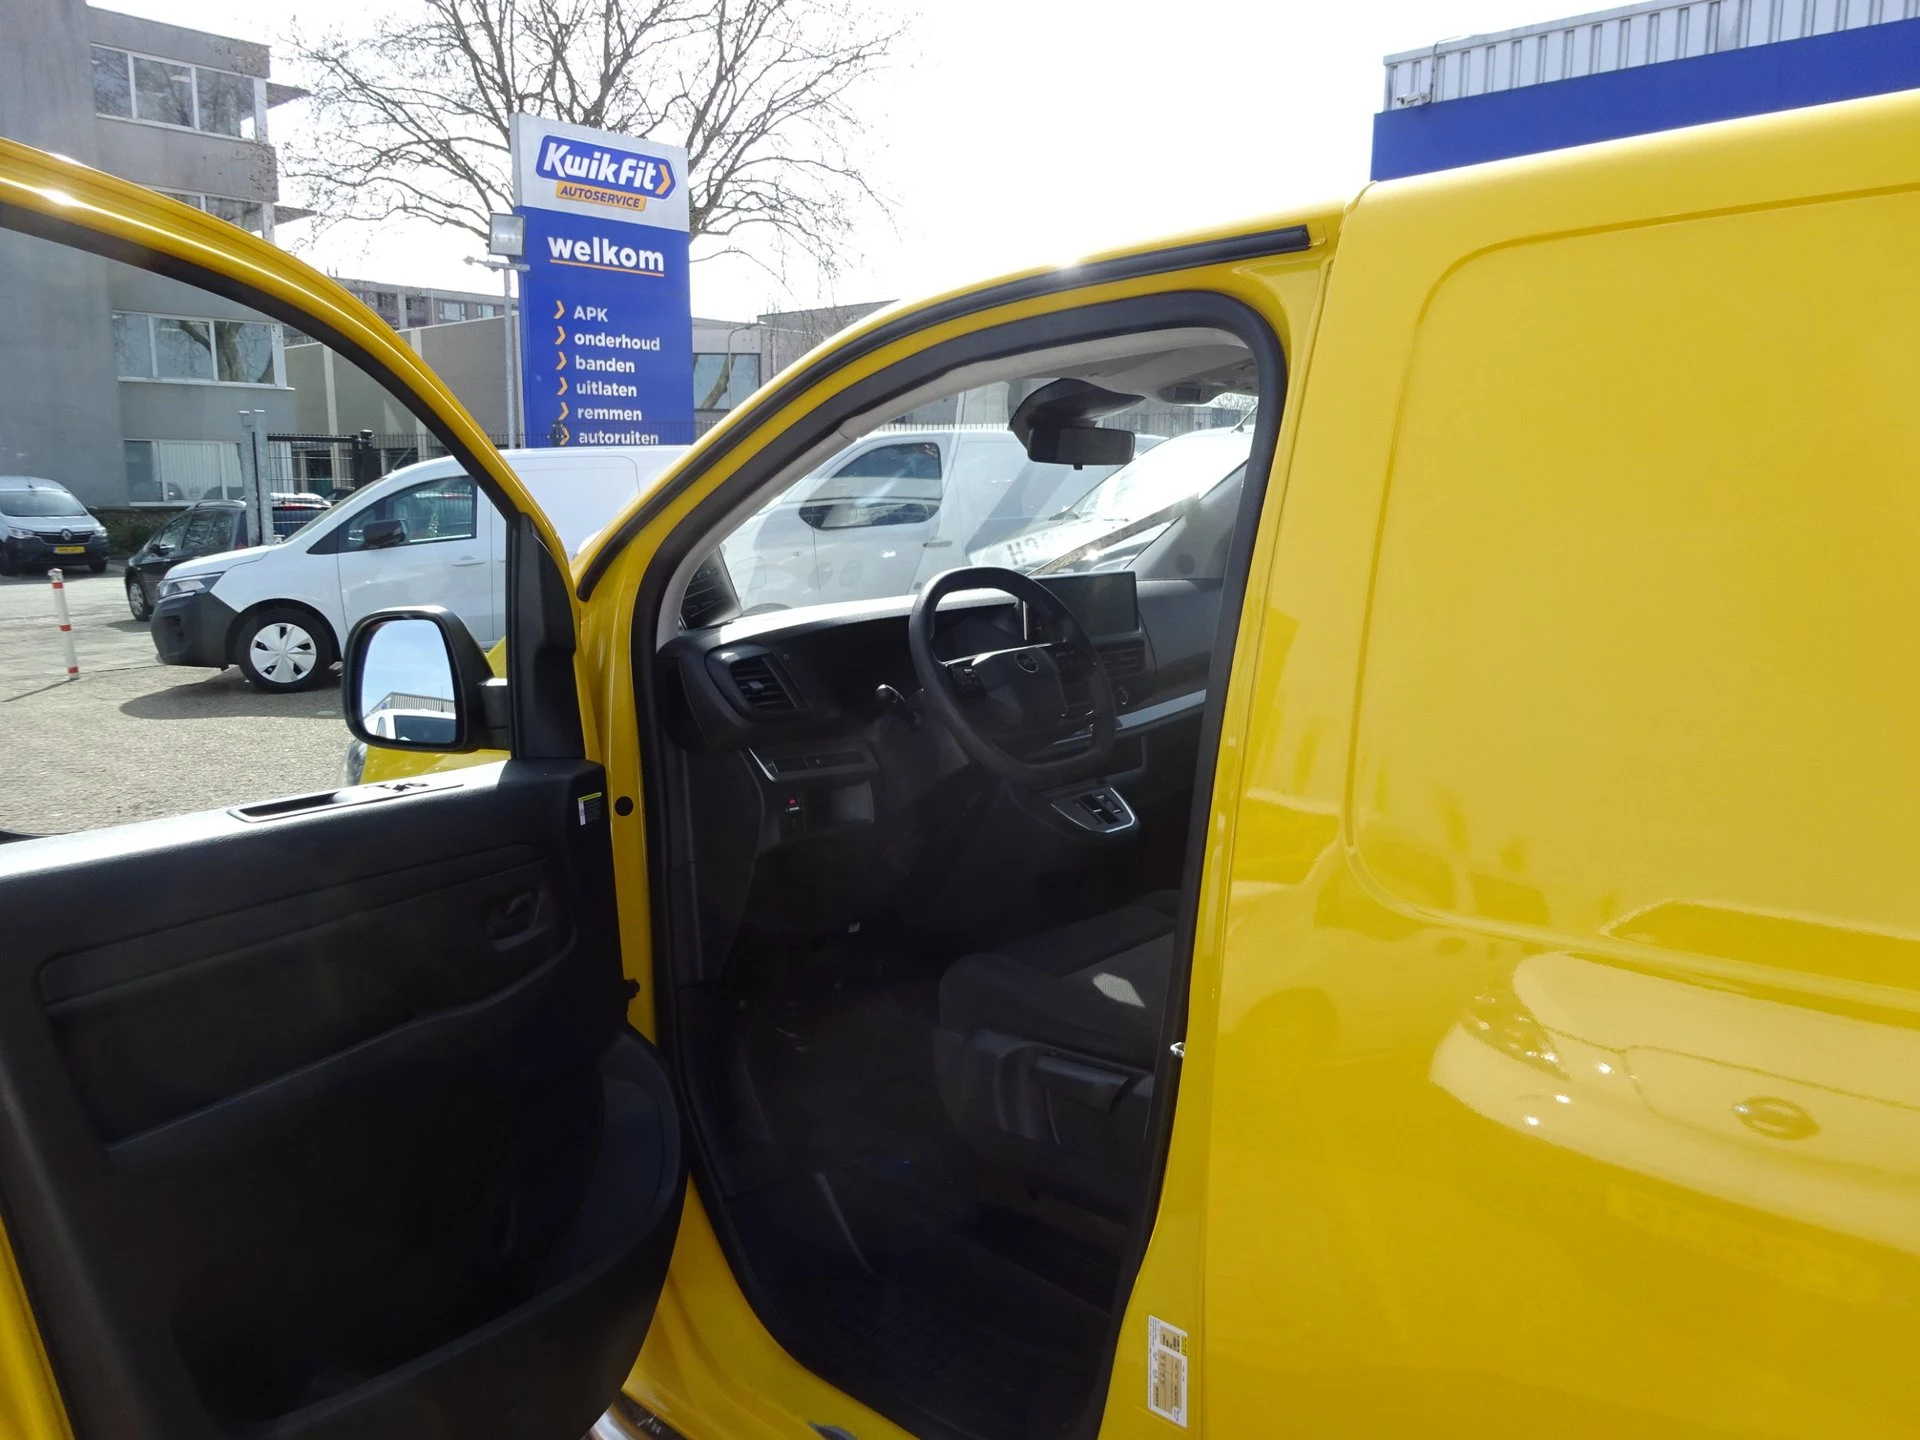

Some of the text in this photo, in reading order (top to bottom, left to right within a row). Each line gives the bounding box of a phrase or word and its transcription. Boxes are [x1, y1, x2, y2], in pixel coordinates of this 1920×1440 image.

[560, 185, 640, 208] AUTOSERVICE
[547, 236, 664, 271] welkom
[573, 305, 608, 322] APK
[574, 332, 660, 351] onderhoud
[575, 355, 635, 373] banden
[576, 381, 637, 397] uitlaten
[577, 406, 642, 421] remmen
[578, 430, 659, 445] autoruiten
